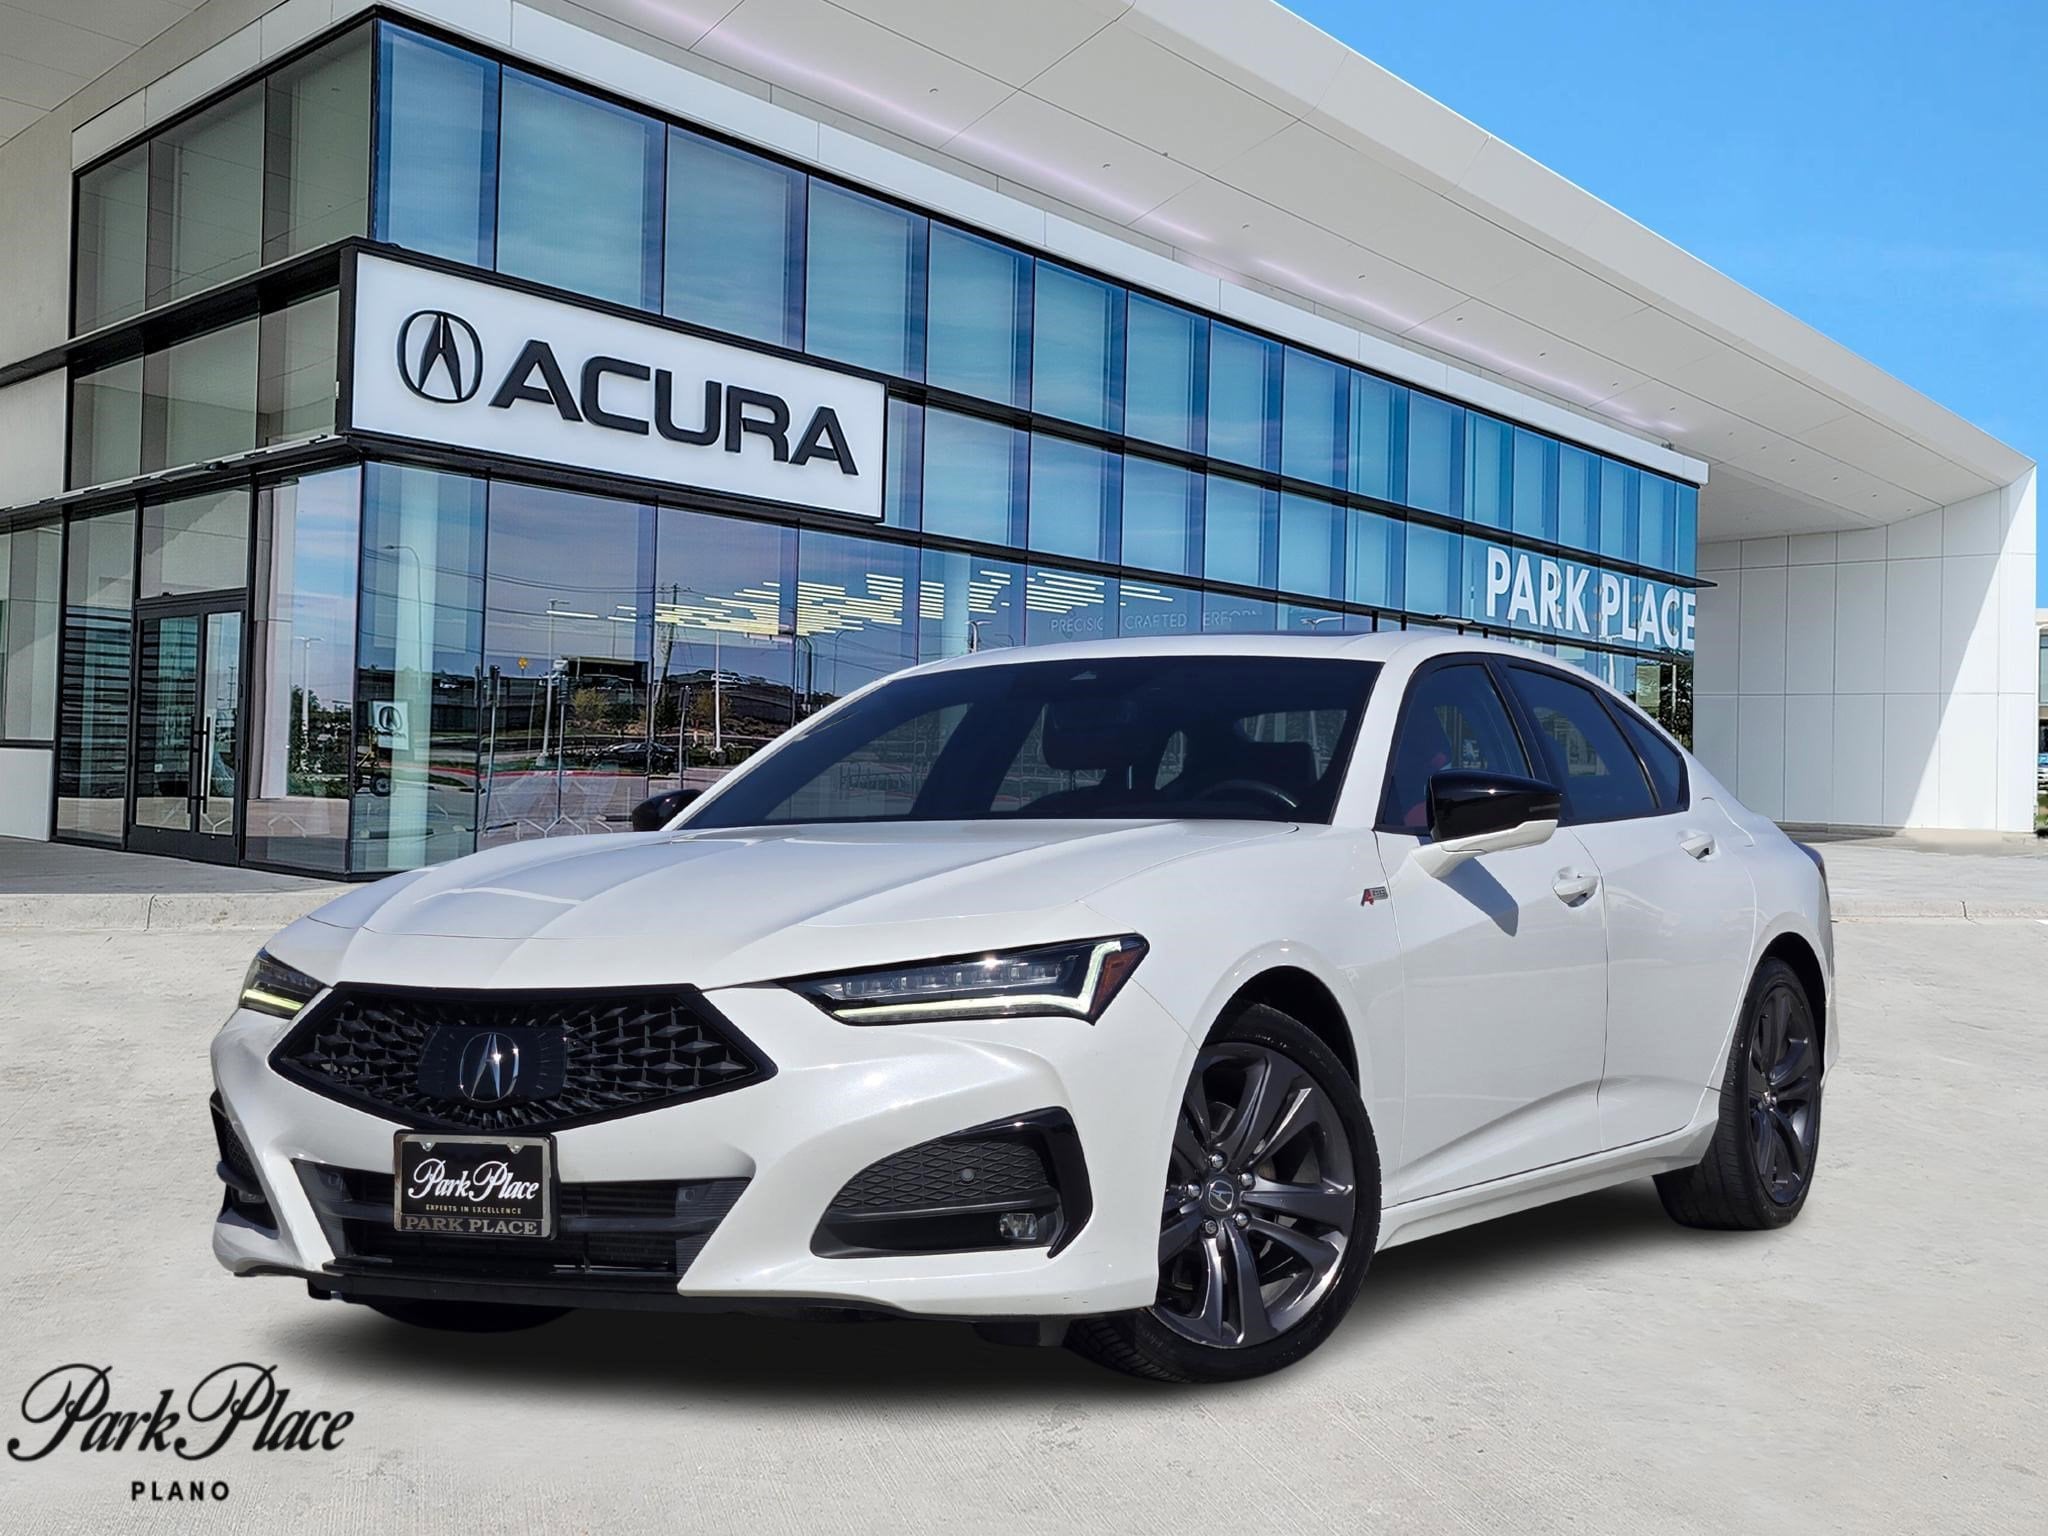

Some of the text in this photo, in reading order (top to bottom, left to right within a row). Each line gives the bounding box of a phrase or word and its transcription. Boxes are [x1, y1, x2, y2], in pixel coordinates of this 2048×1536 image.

[488, 339, 859, 476] ACURA
[1486, 546, 1696, 650] PARK PLACE
[1124, 613, 1187, 630] CRAFTED
[408, 1158, 539, 1202] Park Place
[426, 1204, 457, 1212] EXPERTS
[473, 1206, 521, 1215] EXCELLENCE
[405, 1216, 537, 1235] PARK PLACE
